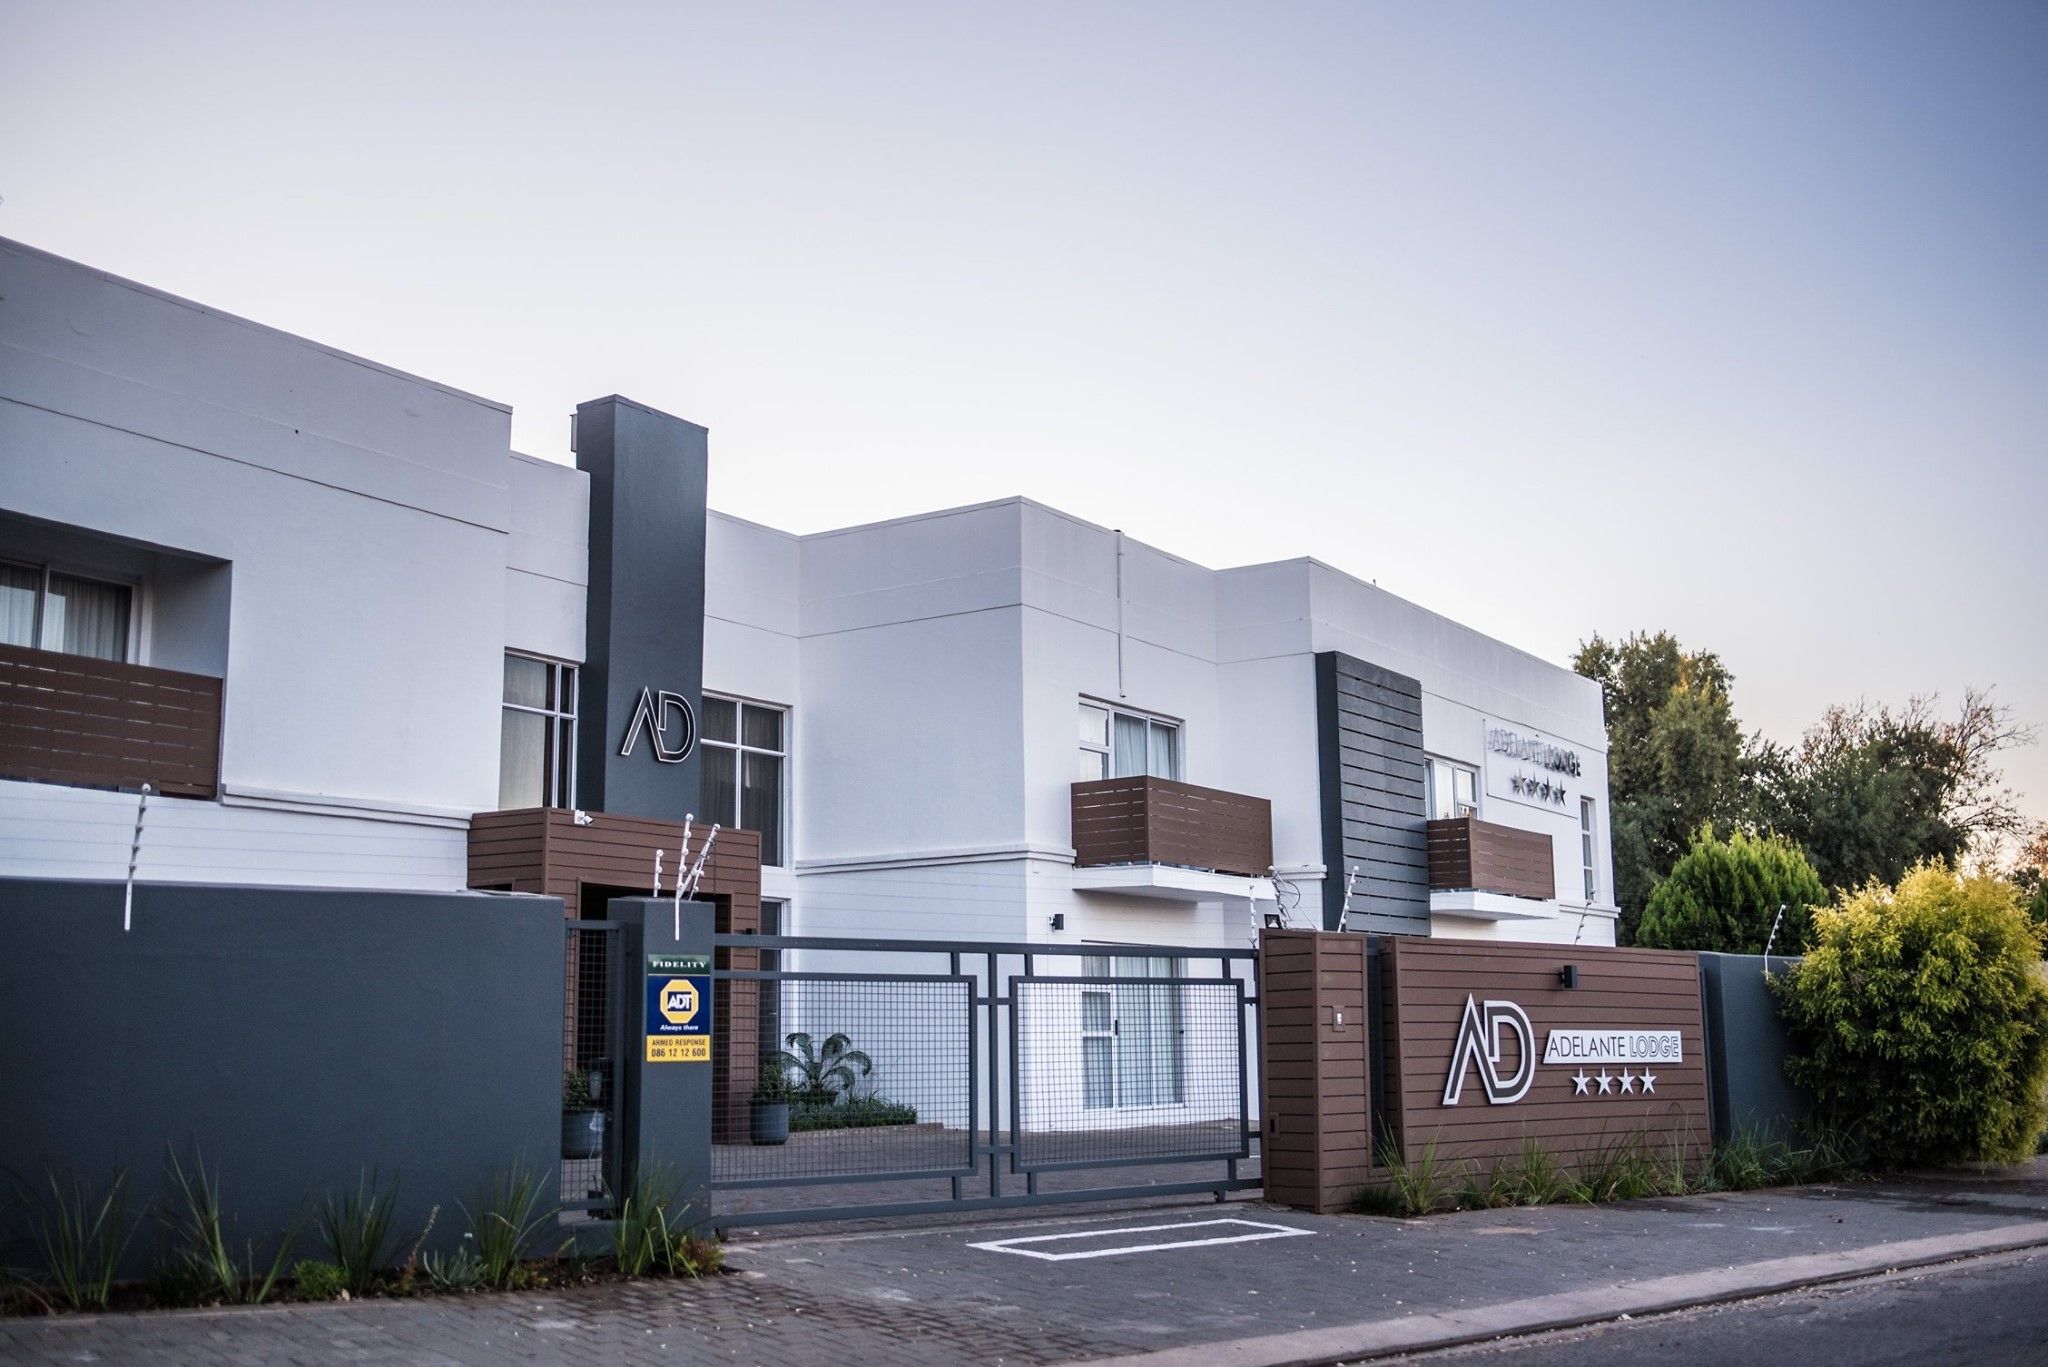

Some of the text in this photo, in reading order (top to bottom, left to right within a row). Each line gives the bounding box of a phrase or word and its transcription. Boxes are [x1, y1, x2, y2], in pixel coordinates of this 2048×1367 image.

[668, 994, 691, 1009] ADT
[651, 1049, 706, 1057] 086 12 12 600
[1548, 1035, 1679, 1057] ADELANTE LODGE
